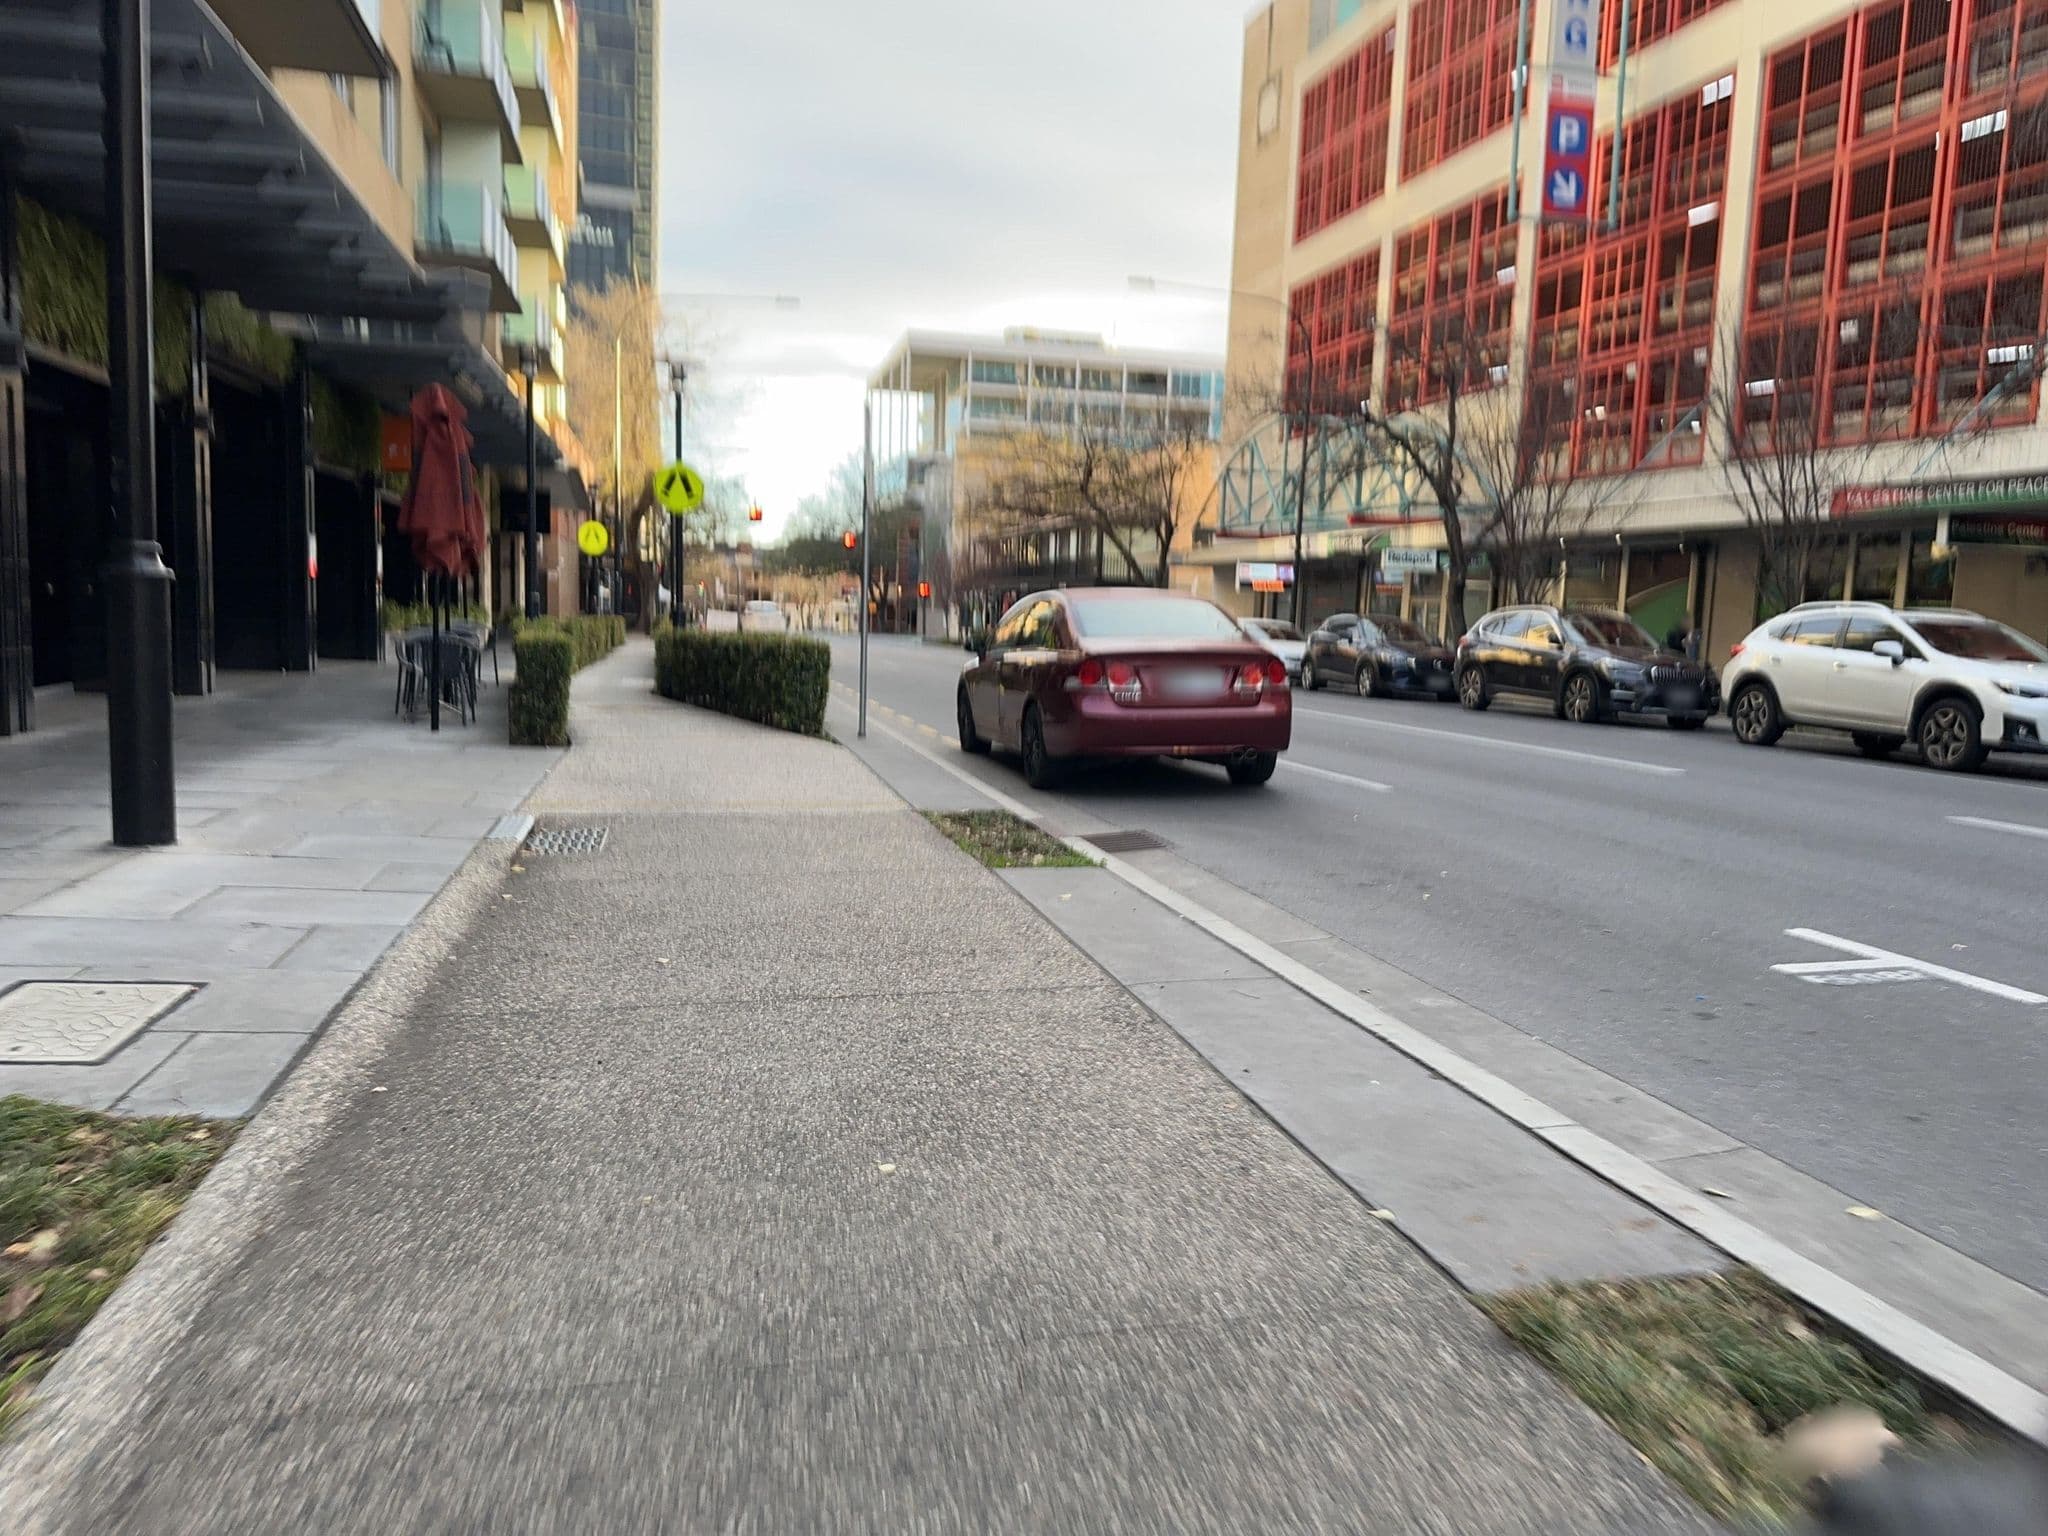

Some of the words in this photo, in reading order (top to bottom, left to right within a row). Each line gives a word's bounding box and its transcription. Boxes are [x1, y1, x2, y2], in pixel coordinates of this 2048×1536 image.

[1557, 115, 1581, 155] P
[1927, 481, 1976, 503] CENTER
[1977, 478, 2005, 500] FOR
